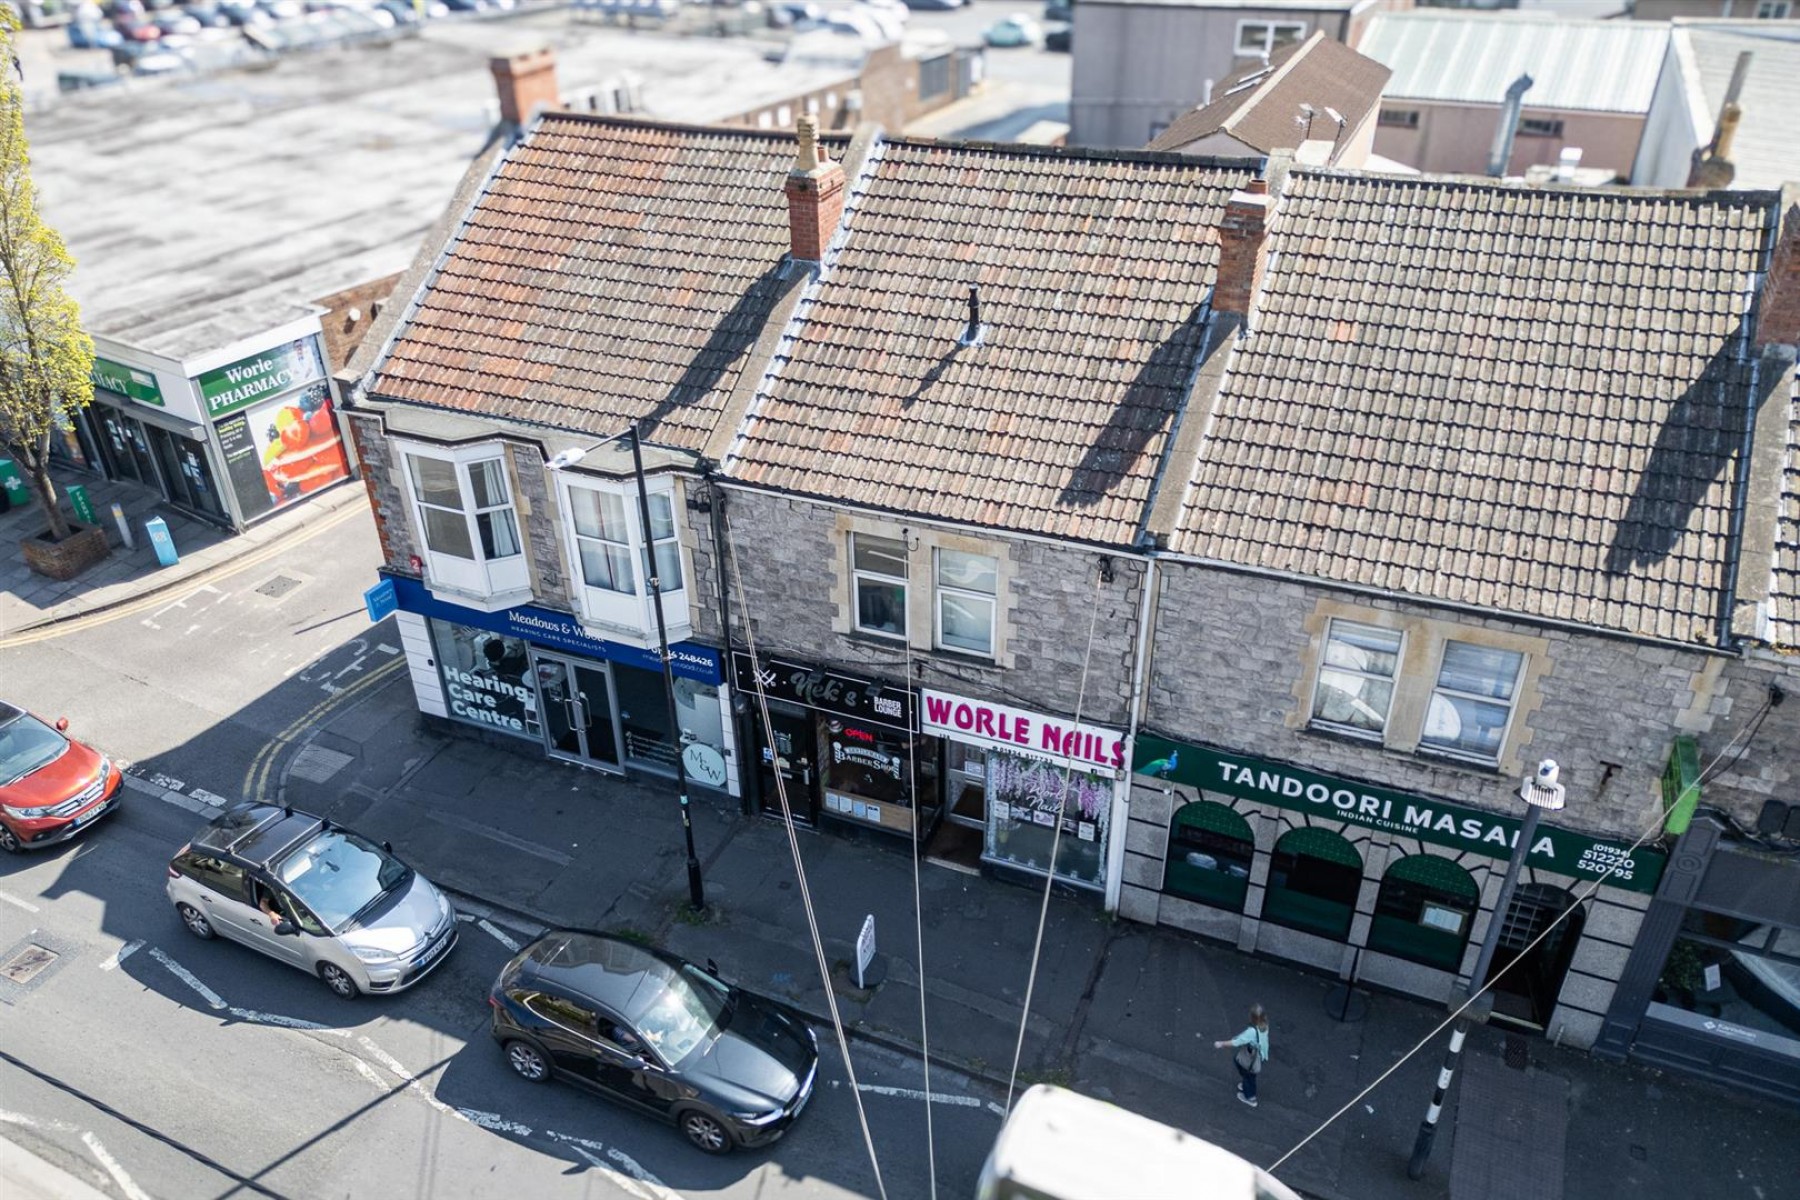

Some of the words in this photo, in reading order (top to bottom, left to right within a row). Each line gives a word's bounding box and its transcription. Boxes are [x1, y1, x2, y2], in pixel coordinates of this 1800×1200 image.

[225, 358, 274, 384] Worle
[209, 368, 296, 411] PHARMACY
[508, 610, 560, 632] Meadows
[561, 622, 571, 634] &
[511, 625, 541, 637] HEARING
[543, 633, 561, 642] CARE
[563, 637, 607, 653] SPECIALISTS
[678, 651, 714, 667] 248426
[443, 664, 529, 704] Hearing
[448, 682, 497, 708] Care
[452, 699, 522, 731] Centre
[874, 696, 901, 710] BARBER
[874, 703, 902, 718] LOUNGE
[844, 728, 875, 743] OPEN
[926, 695, 1030, 745] WORLE
[1041, 723, 1126, 767] NAILS
[1218, 761, 1393, 819] TANDOORI
[1336, 809, 1373, 824] INDIAN
[1376, 817, 1419, 834] CUISINE
[1582, 849, 1635, 869] 512220
